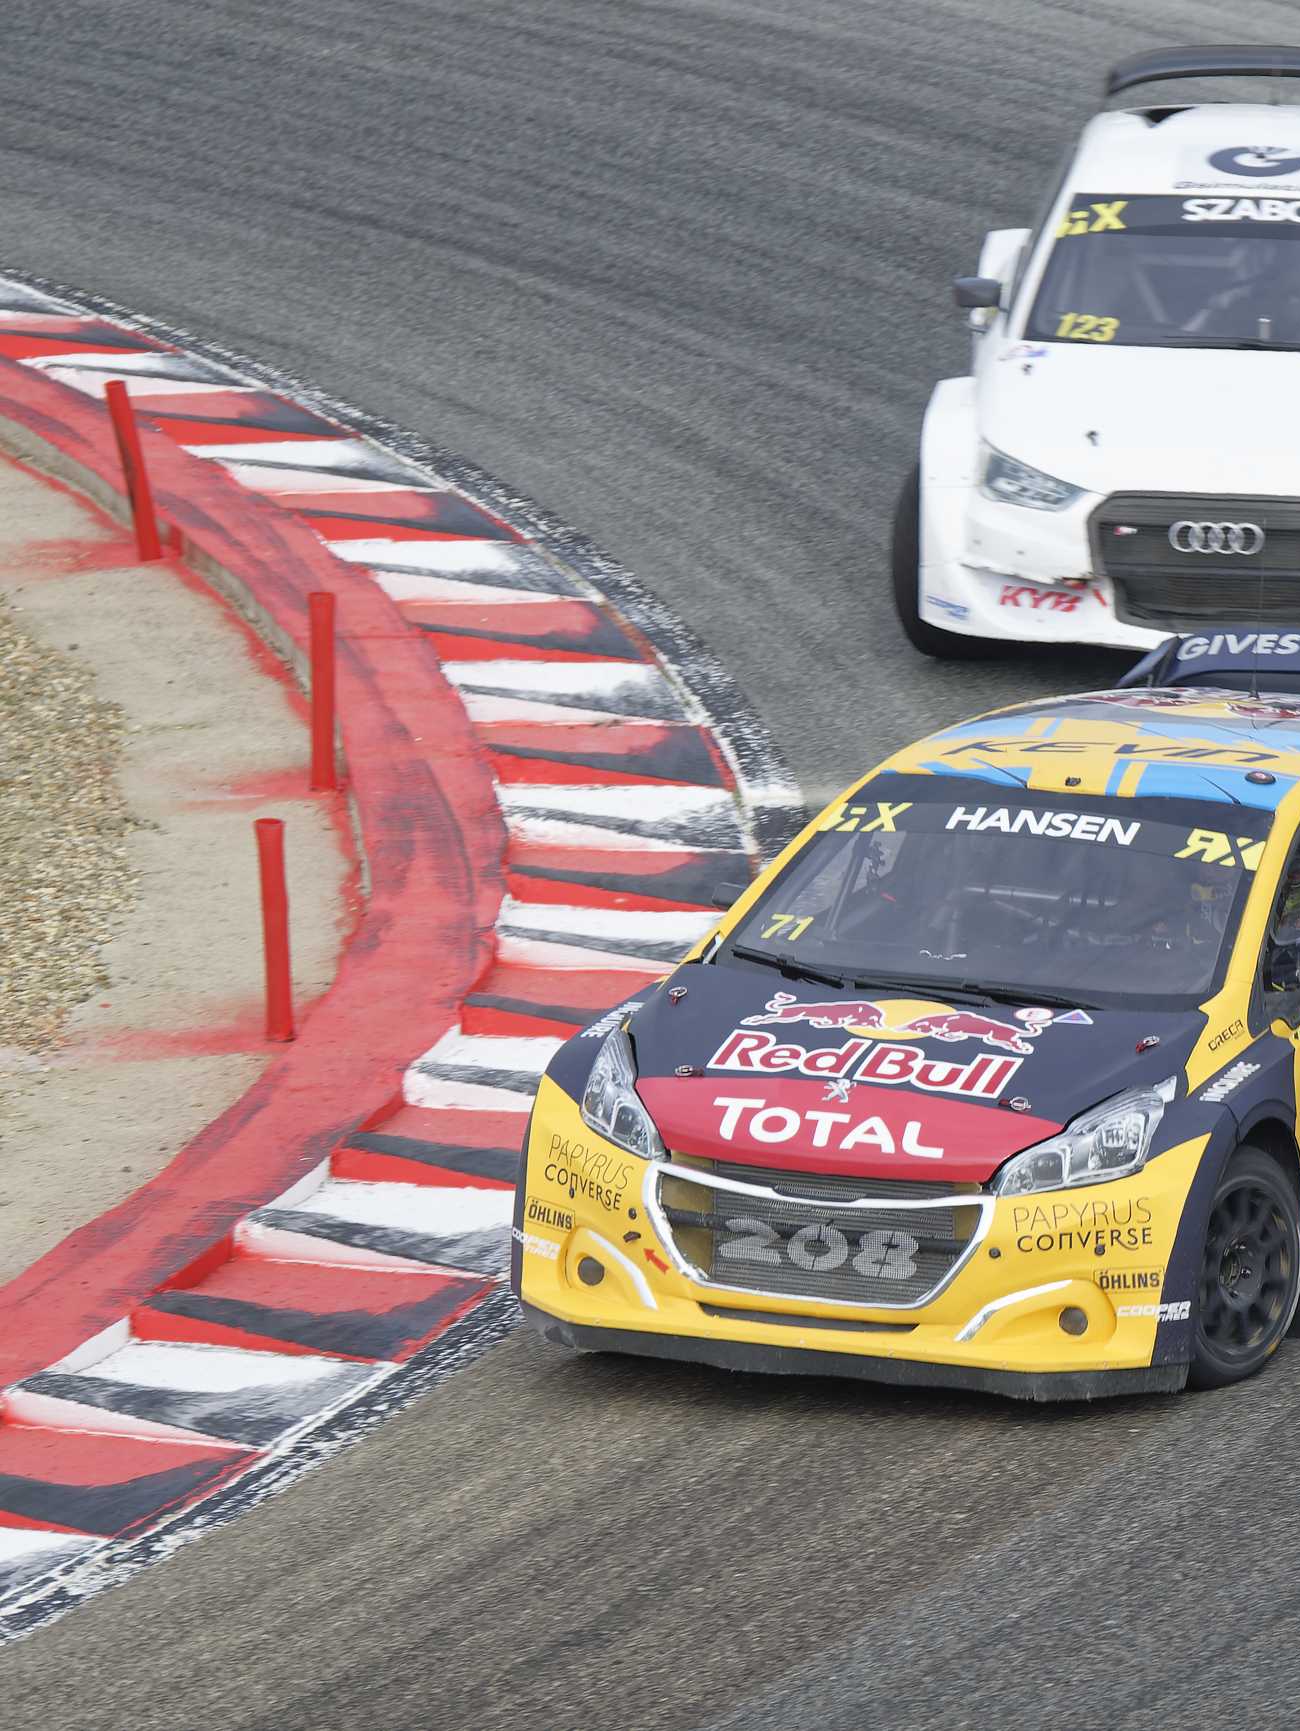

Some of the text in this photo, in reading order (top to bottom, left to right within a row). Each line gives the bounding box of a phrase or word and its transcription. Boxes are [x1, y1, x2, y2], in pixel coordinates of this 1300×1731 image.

[1056, 312, 1121, 344] 123
[943, 739, 1282, 763] KEVIN
[945, 806, 1141, 846] HANSEN
[760, 913, 815, 941] 71
[707, 1029, 1024, 1099] Red Bull
[713, 1096, 945, 1159] TOTAL
[548, 1133, 635, 1190] PAPYRUS
[528, 1199, 574, 1231] ÖHLINS
[1012, 1196, 1153, 1233] PAPYRUS
[718, 1217, 920, 1280] 208
[1099, 1269, 1161, 1290] ÖHLINS
[1116, 1301, 1191, 1318] COOPER
